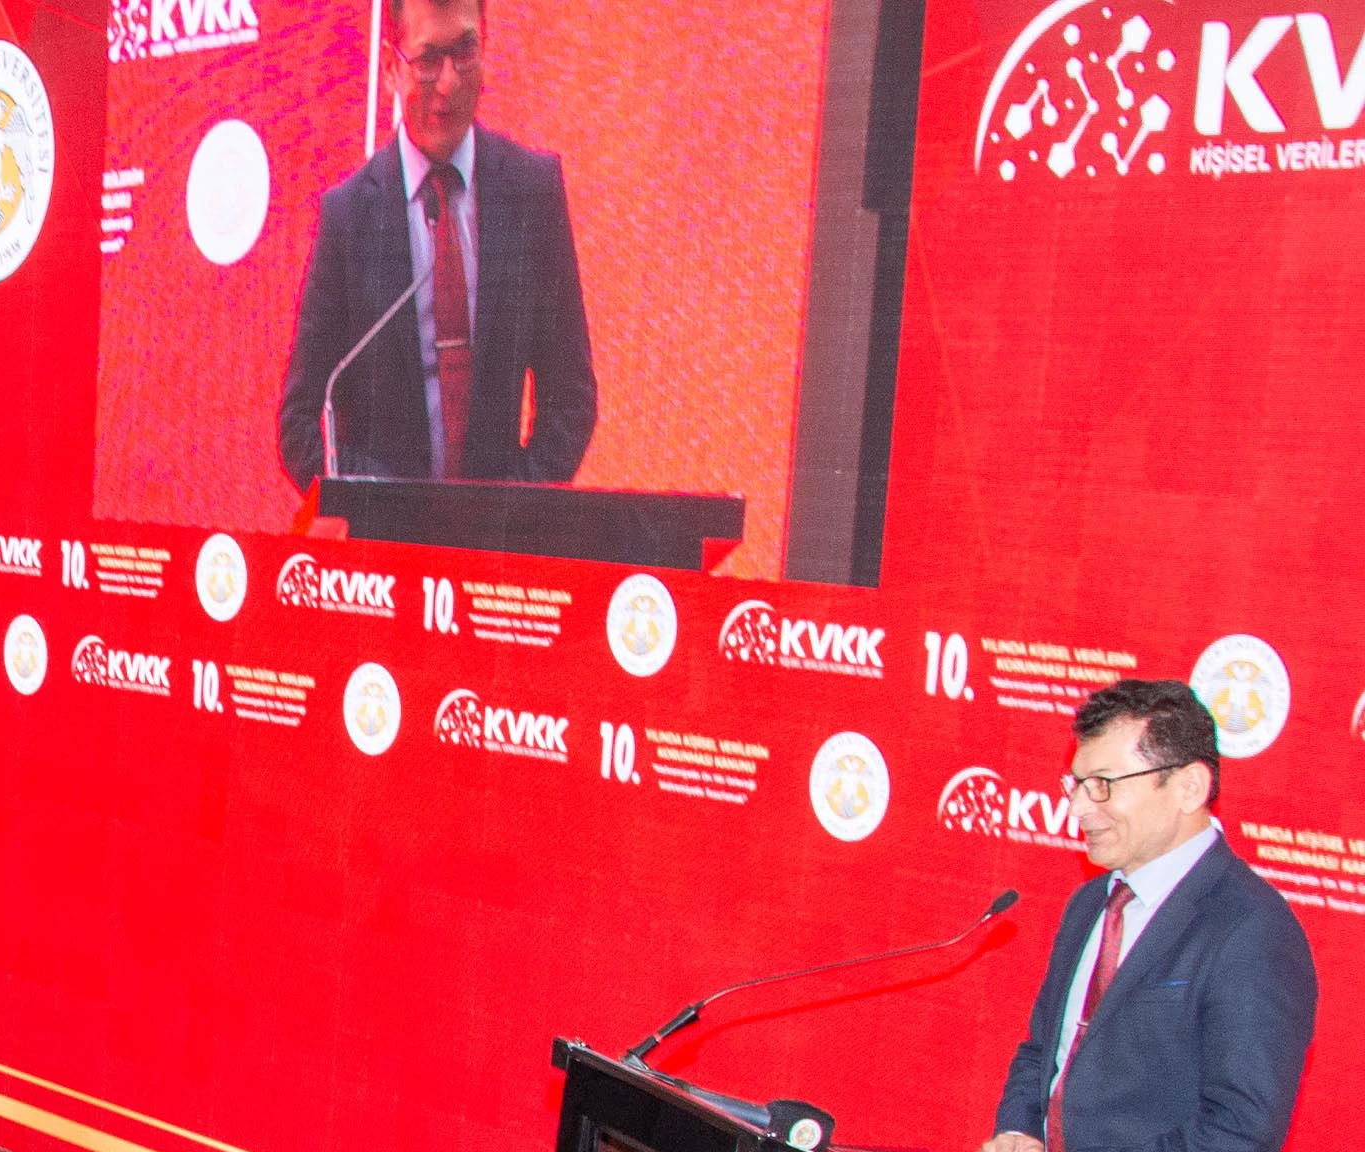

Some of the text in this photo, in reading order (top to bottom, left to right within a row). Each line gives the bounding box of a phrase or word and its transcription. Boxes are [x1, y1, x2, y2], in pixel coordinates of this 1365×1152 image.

[151, 0, 258, 42] KVKK
[1189, 140, 1271, 180] KİŞİSEL
[60, 540, 90, 590] 10.
[320, 568, 397, 608] KVKK
[422, 576, 459, 635] 10.
[780, 617, 886, 668] KVKK
[924, 631, 975, 701] 10.
[108, 650, 172, 689] KVKK
[192, 659, 224, 713] 10.
[484, 705, 569, 753] KVKK
[600, 720, 641, 785] 10.
